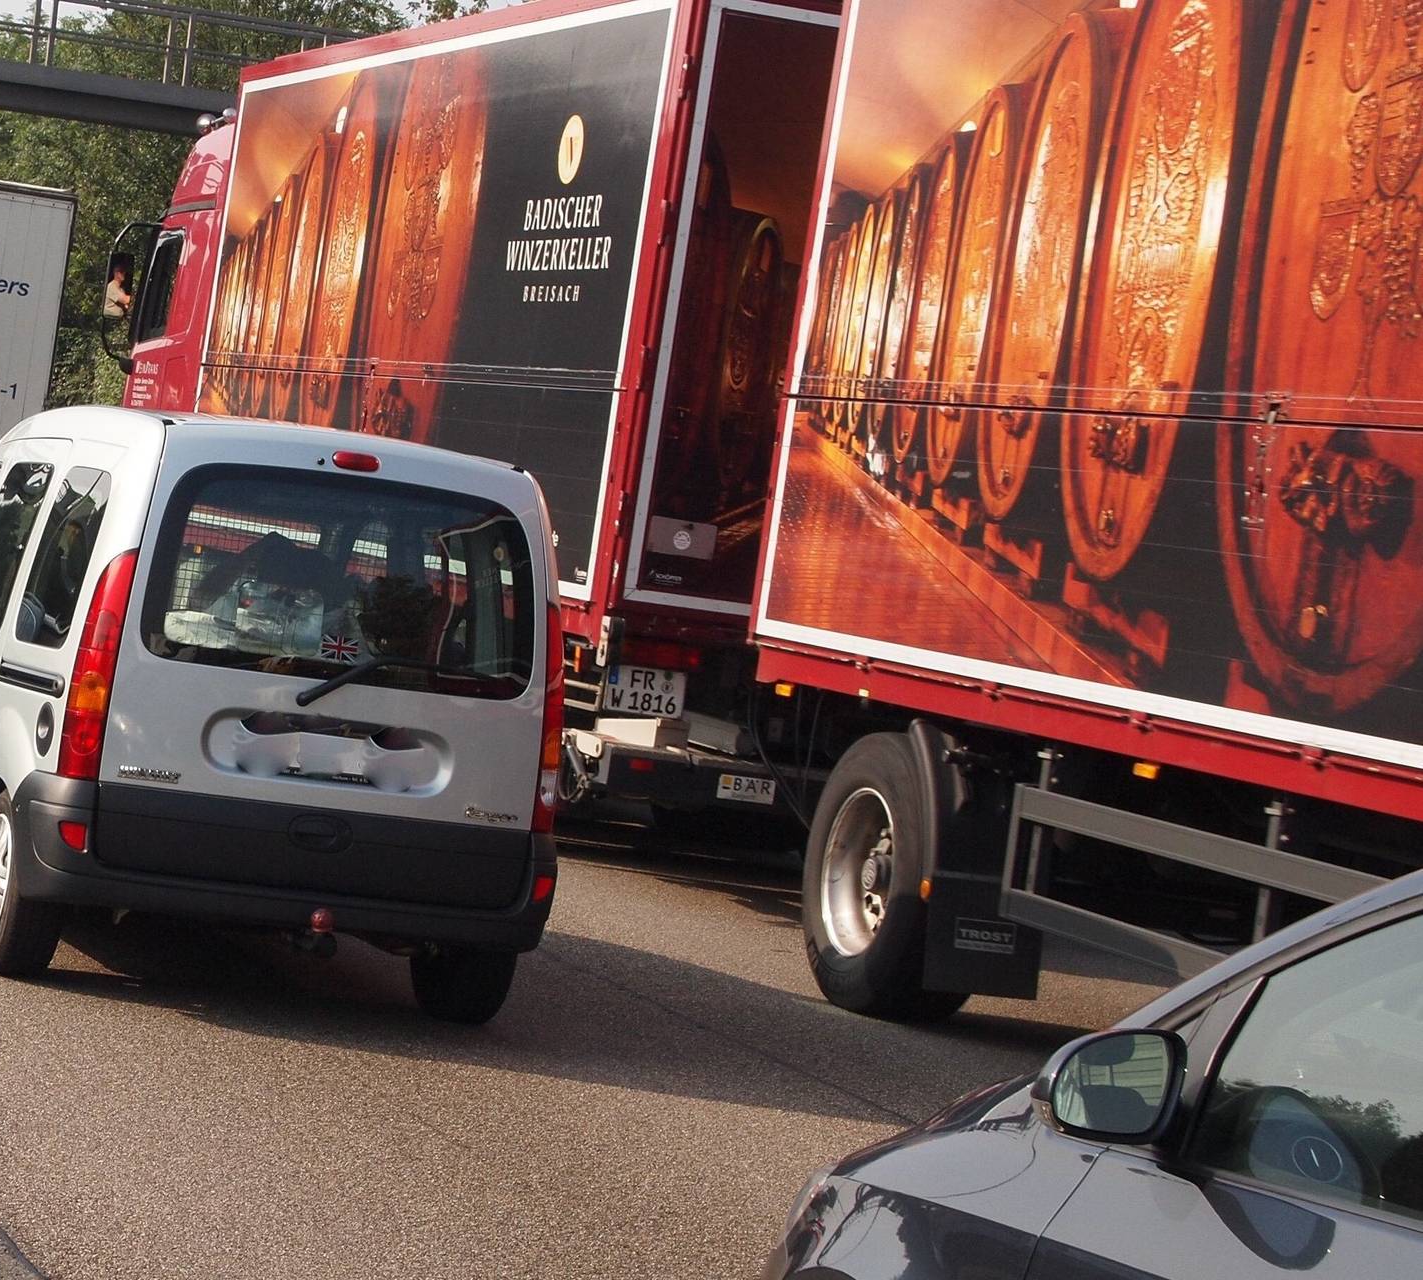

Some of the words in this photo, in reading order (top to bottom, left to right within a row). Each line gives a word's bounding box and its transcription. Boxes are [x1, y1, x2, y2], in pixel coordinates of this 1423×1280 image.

[523, 194, 603, 231] BADISCHER
[506, 236, 612, 271] WINZERKELLER
[523, 285, 581, 302] BREISACH
[630, 669, 656, 691] FR
[611, 688, 624, 708] W
[627, 692, 676, 715] 1816
[732, 777, 771, 795] BÄR
[959, 928, 1012, 943] TROST
